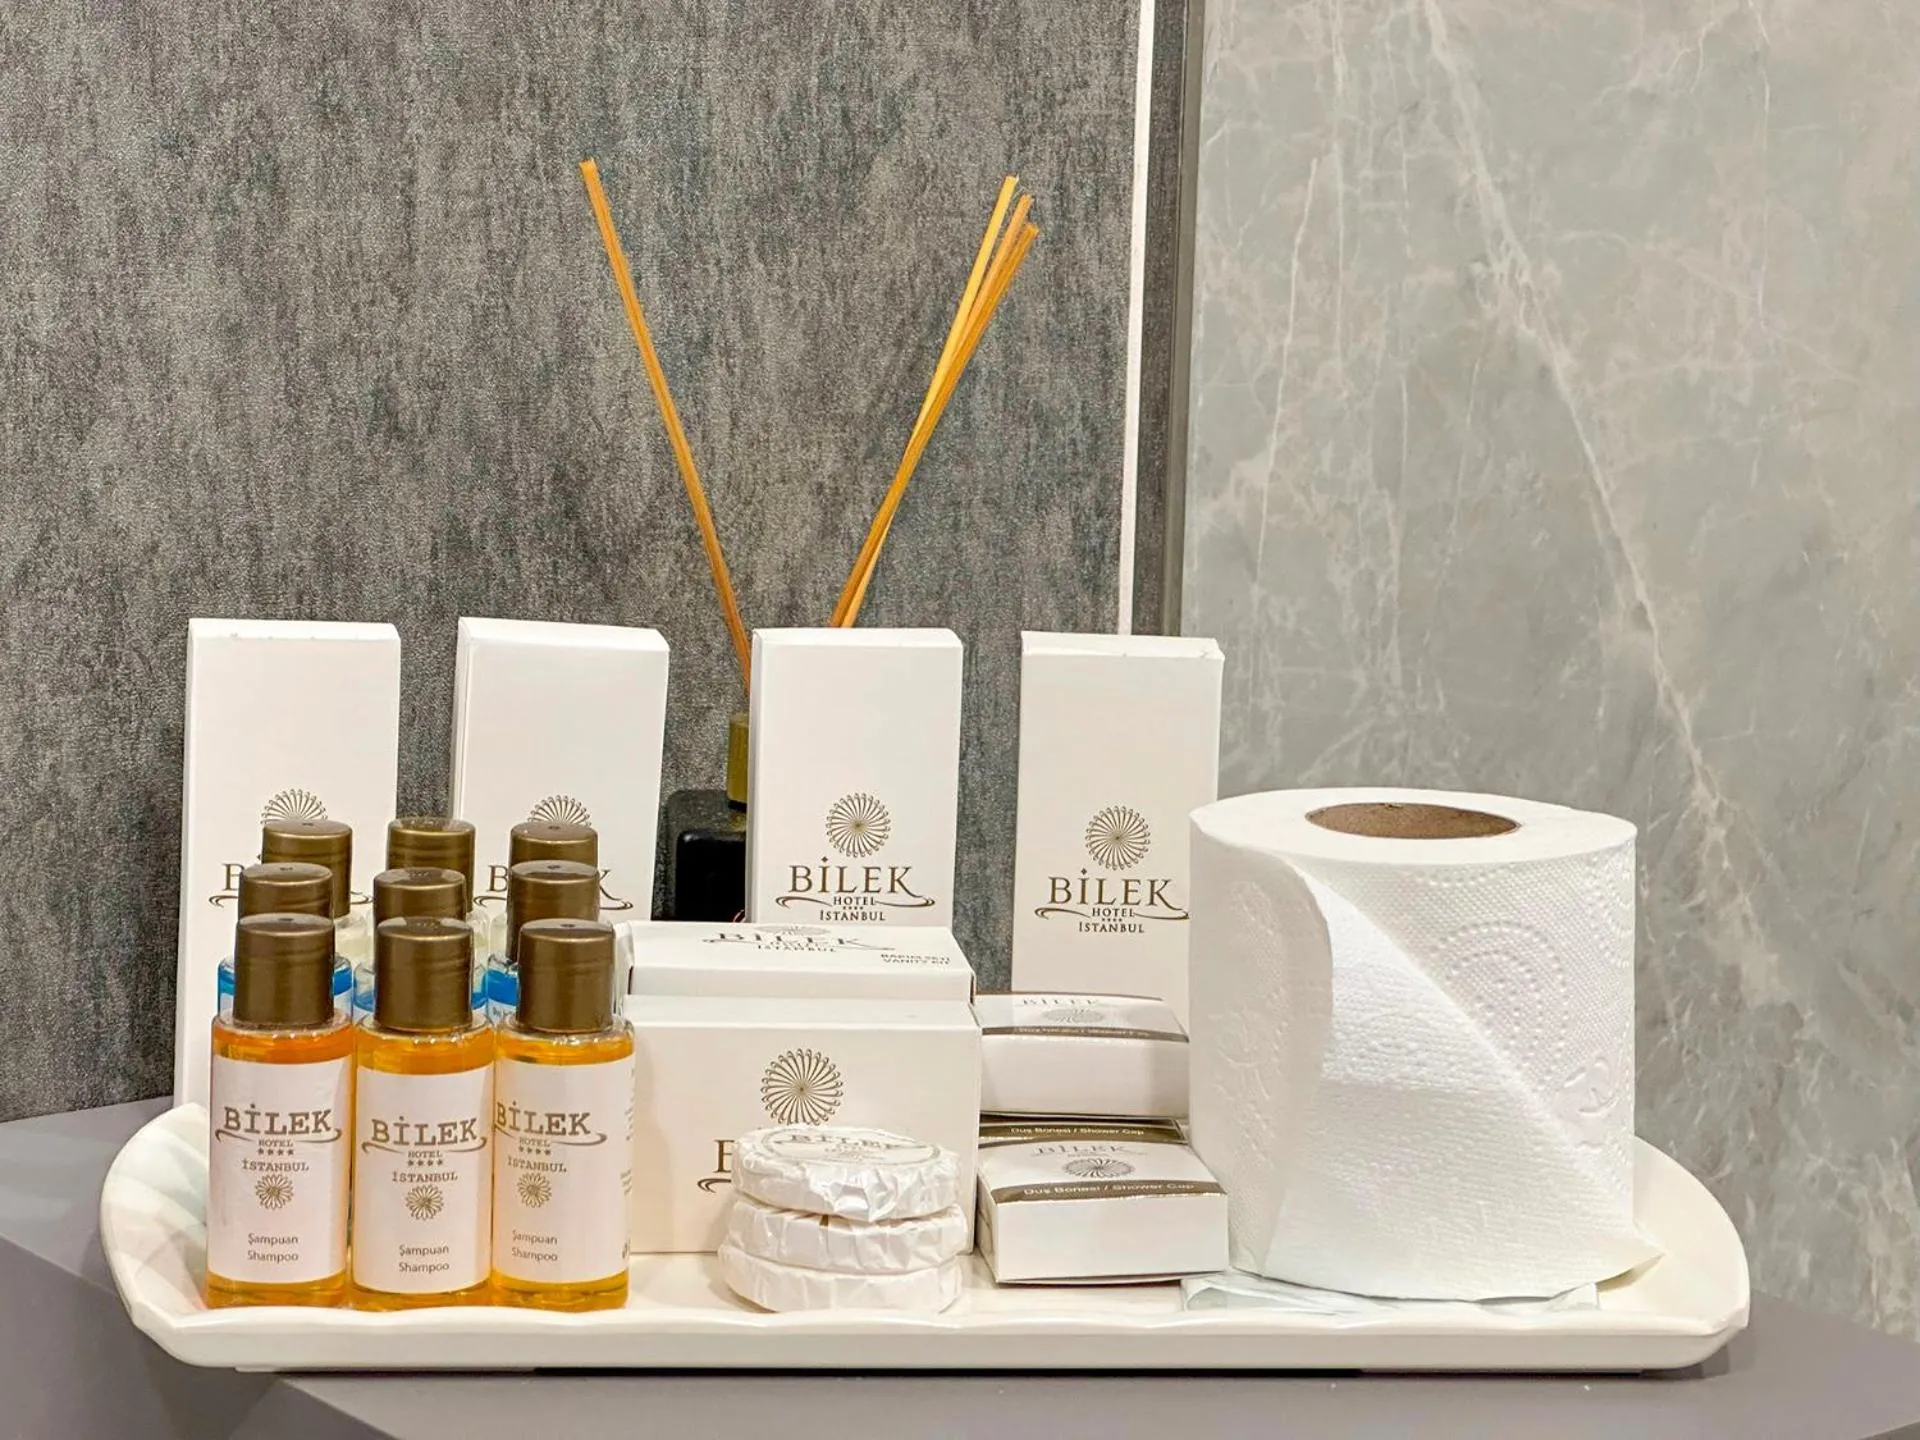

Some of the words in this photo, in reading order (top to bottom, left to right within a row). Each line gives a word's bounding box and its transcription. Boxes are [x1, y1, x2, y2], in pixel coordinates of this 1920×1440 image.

[788, 857, 922, 898] BİLEK
[1048, 868, 1182, 910] BİLEK
[833, 896, 876, 905] HOTEL
[1091, 907, 1135, 917] HOTEL
[223, 1103, 332, 1136] BİLEK
[497, 1100, 592, 1137] BİLEK
[371, 1115, 478, 1147] BİLEK
[258, 1139, 294, 1147] HOTEL
[408, 1150, 443, 1158] HOTEL
[247, 1249, 299, 1263] Shampoo
[511, 1246, 559, 1263] Shampoo
[399, 1260, 450, 1274] Shampoo
